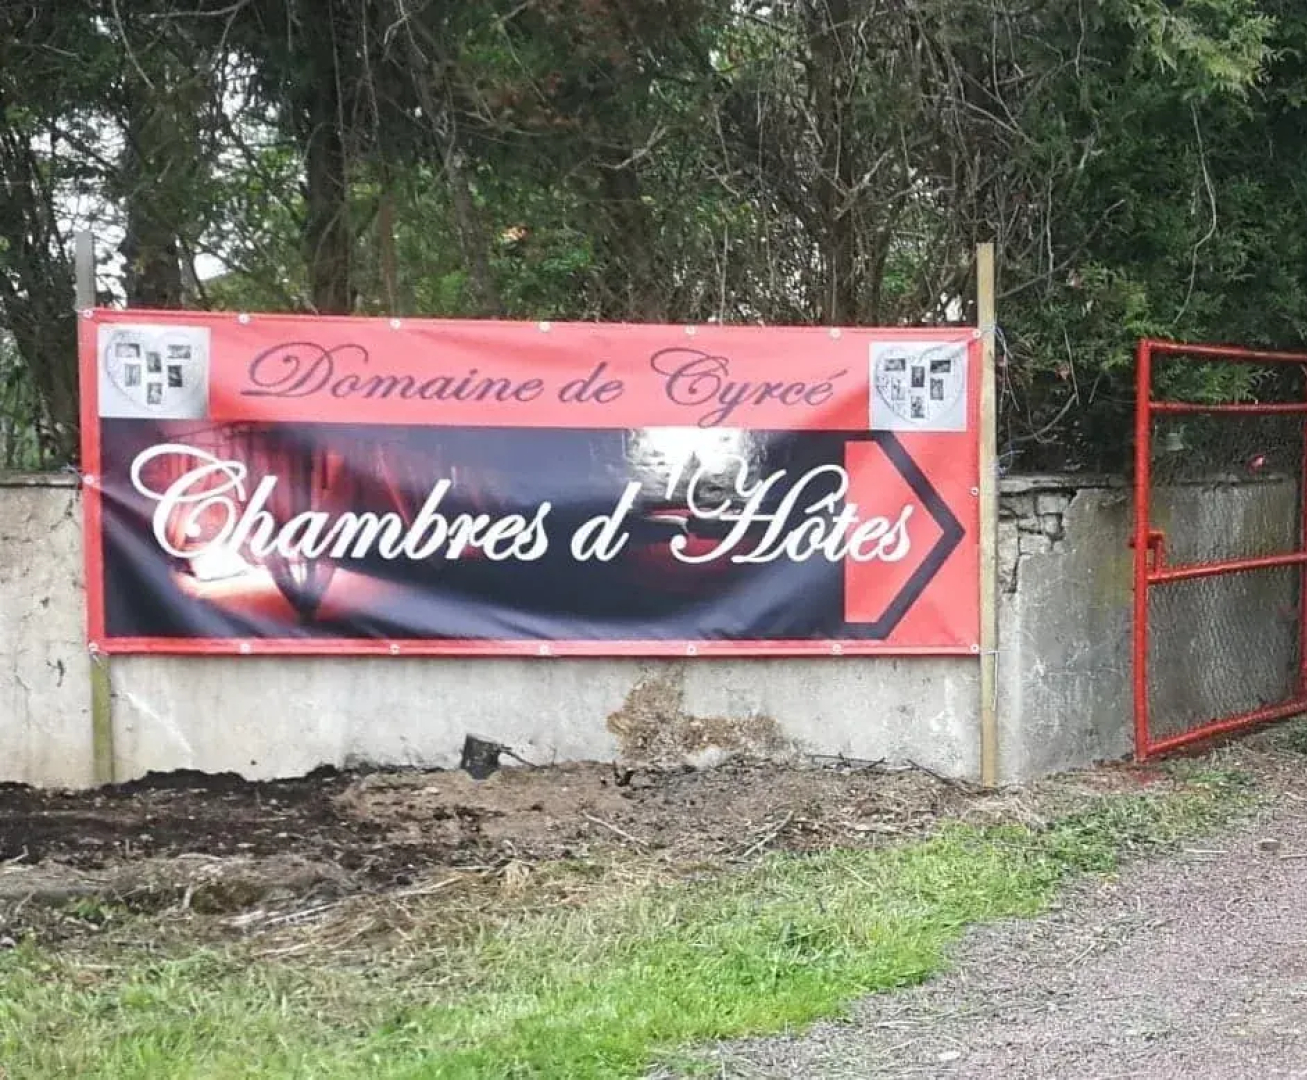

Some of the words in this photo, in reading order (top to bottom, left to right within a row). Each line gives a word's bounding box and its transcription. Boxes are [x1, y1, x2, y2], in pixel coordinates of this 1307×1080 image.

[241, 341, 545, 403] Domaine
[558, 361, 625, 405] de
[650, 347, 848, 428] Cyrcé
[130, 443, 551, 561] Chambres
